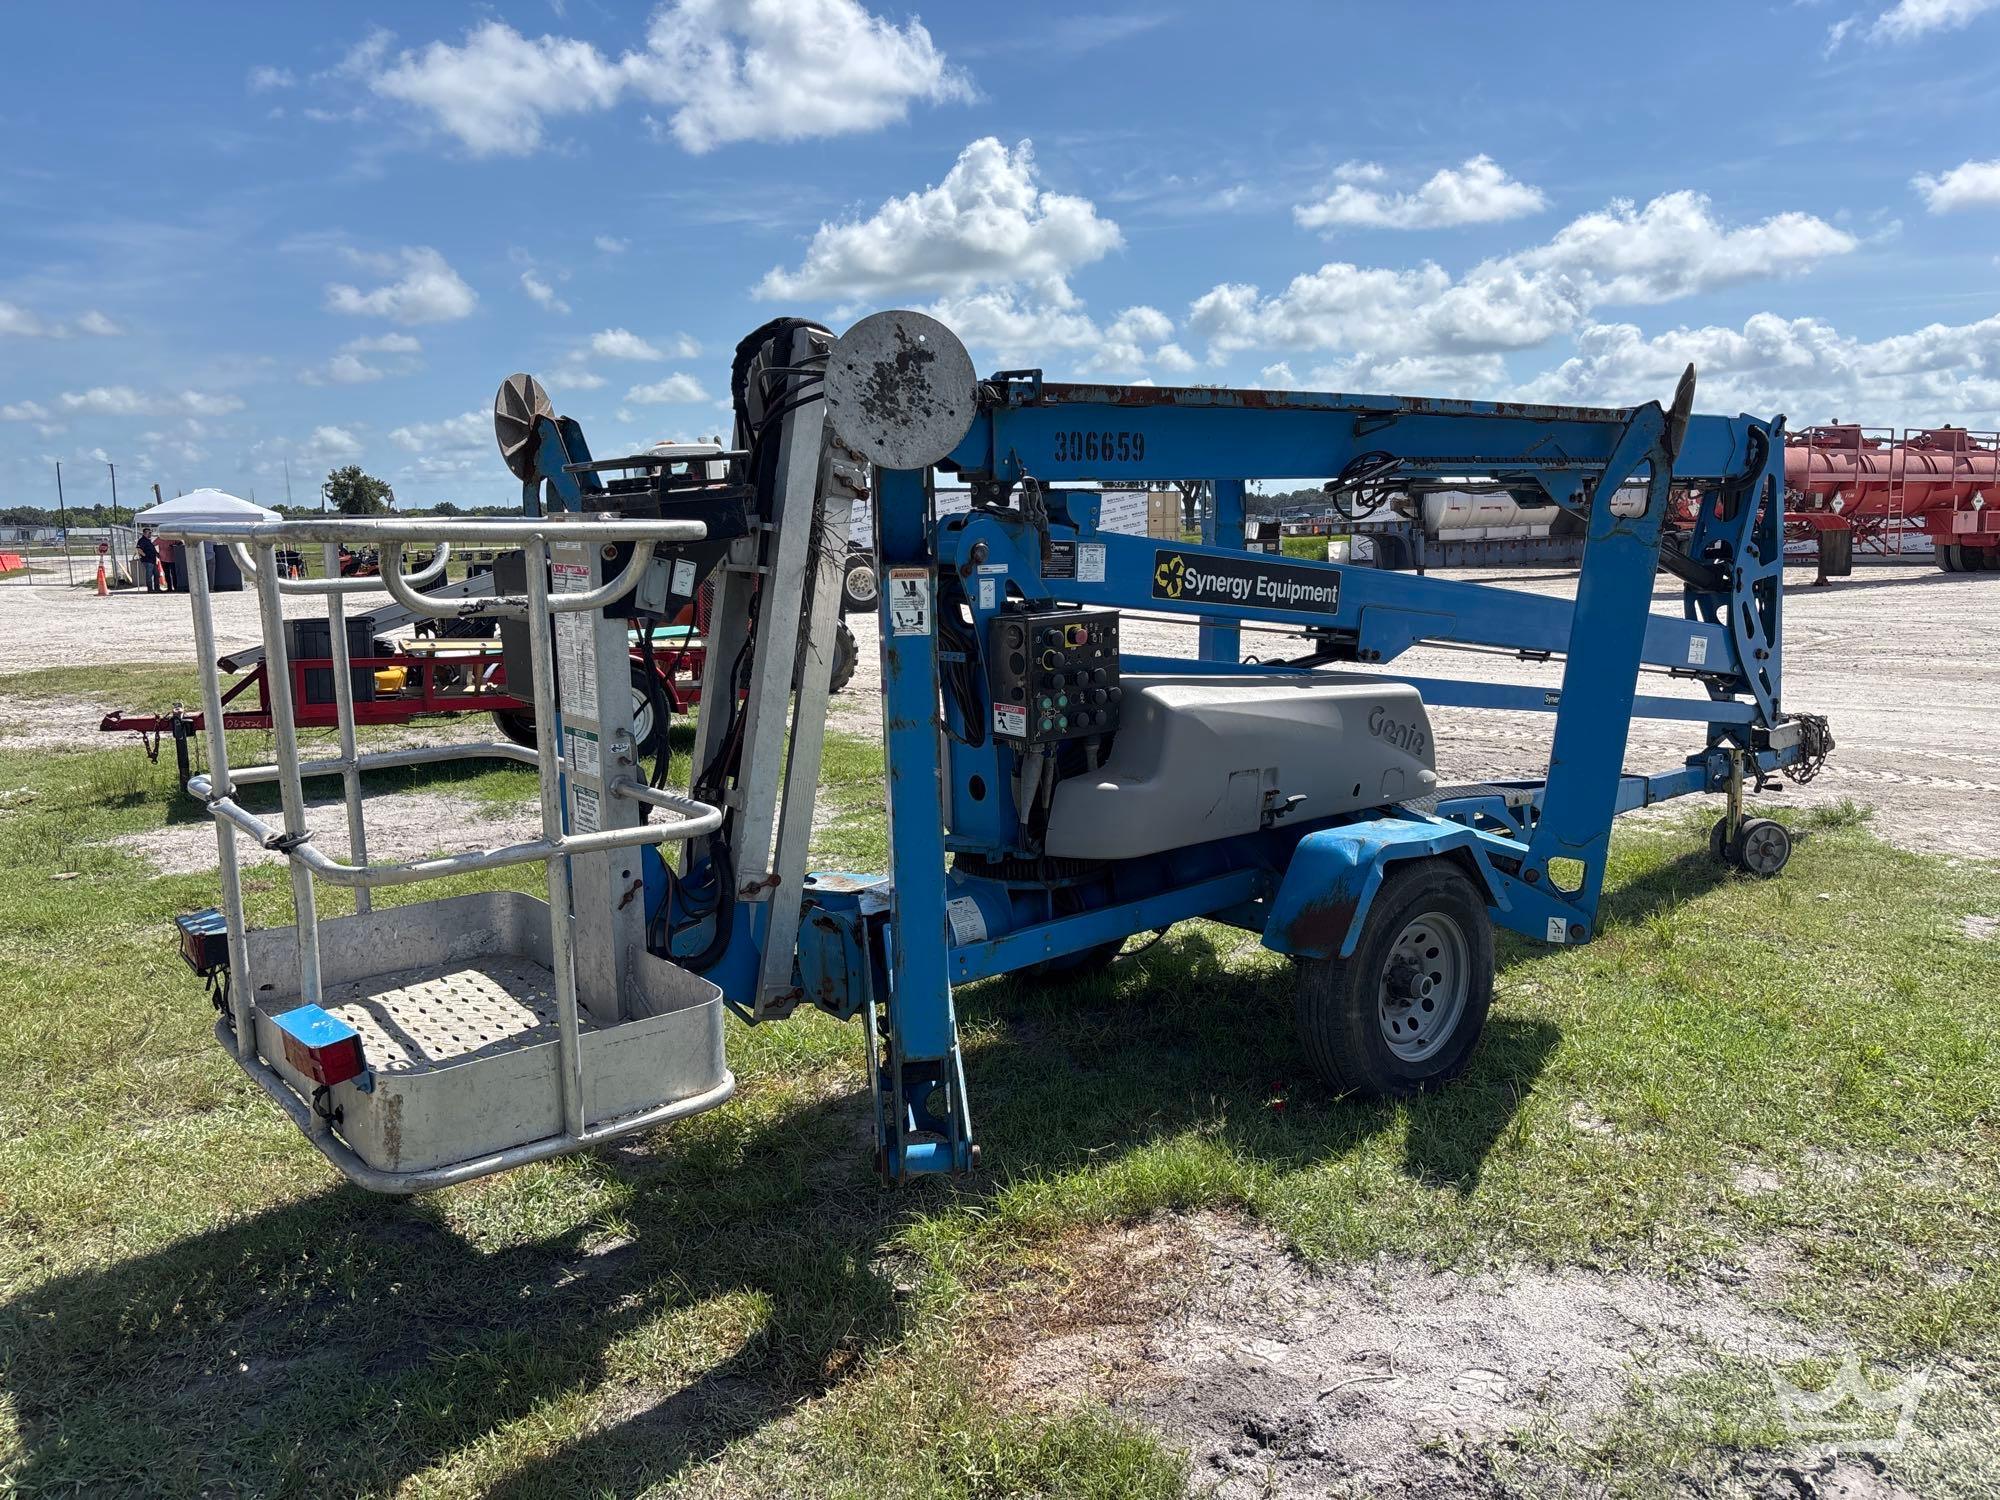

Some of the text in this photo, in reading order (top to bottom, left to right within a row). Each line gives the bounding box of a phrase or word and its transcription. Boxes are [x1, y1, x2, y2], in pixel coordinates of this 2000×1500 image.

[1054, 431, 1145, 462] 306659
[1184, 567, 1338, 605] Synergy Equipment
[1545, 694, 1560, 705] Syner
[1368, 705, 1425, 756] Genie
